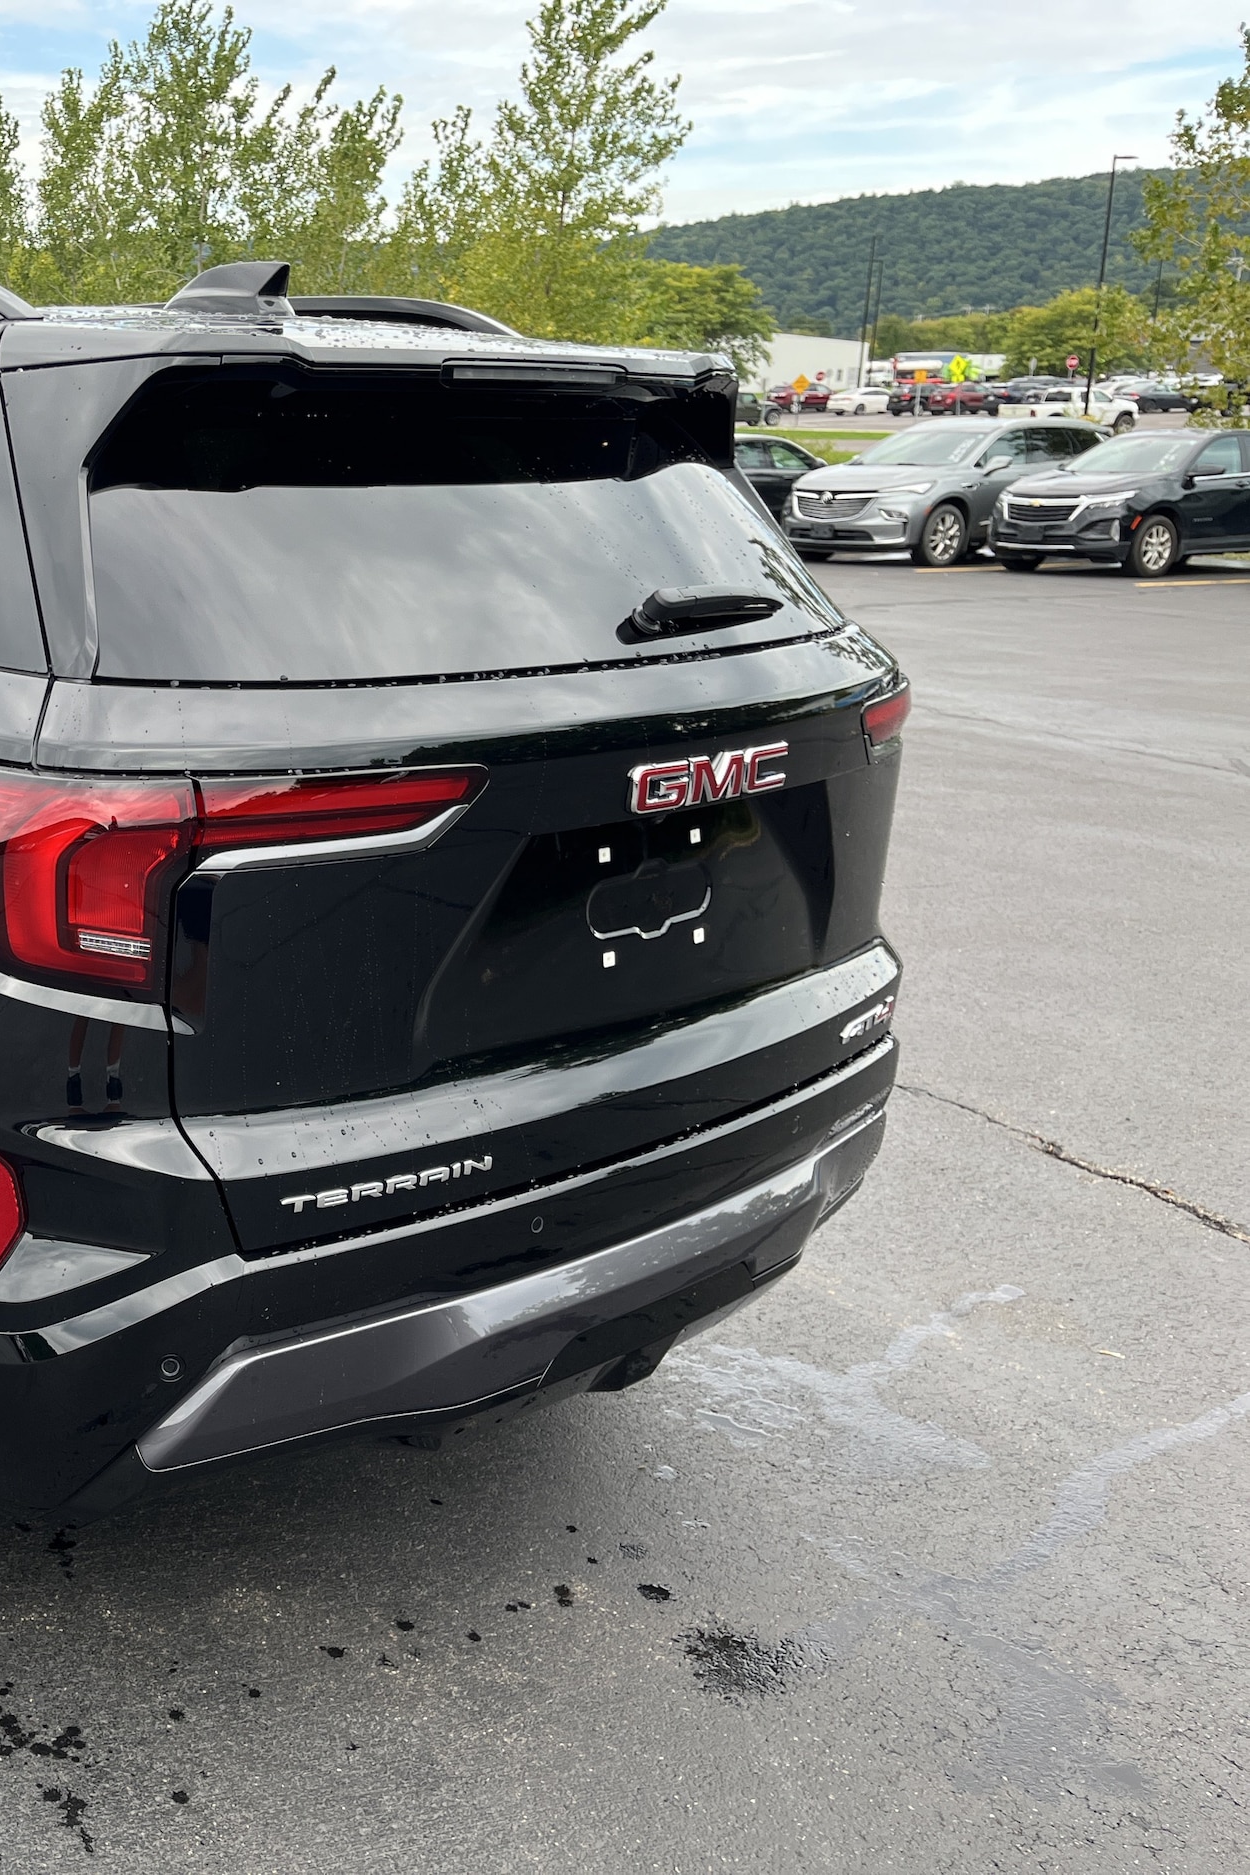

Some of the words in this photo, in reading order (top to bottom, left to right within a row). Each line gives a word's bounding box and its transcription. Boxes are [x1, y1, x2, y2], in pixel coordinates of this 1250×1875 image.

[627, 740, 789, 814] GMC
[839, 995, 894, 1045] AT4
[280, 1155, 493, 1213] TERRAIN
